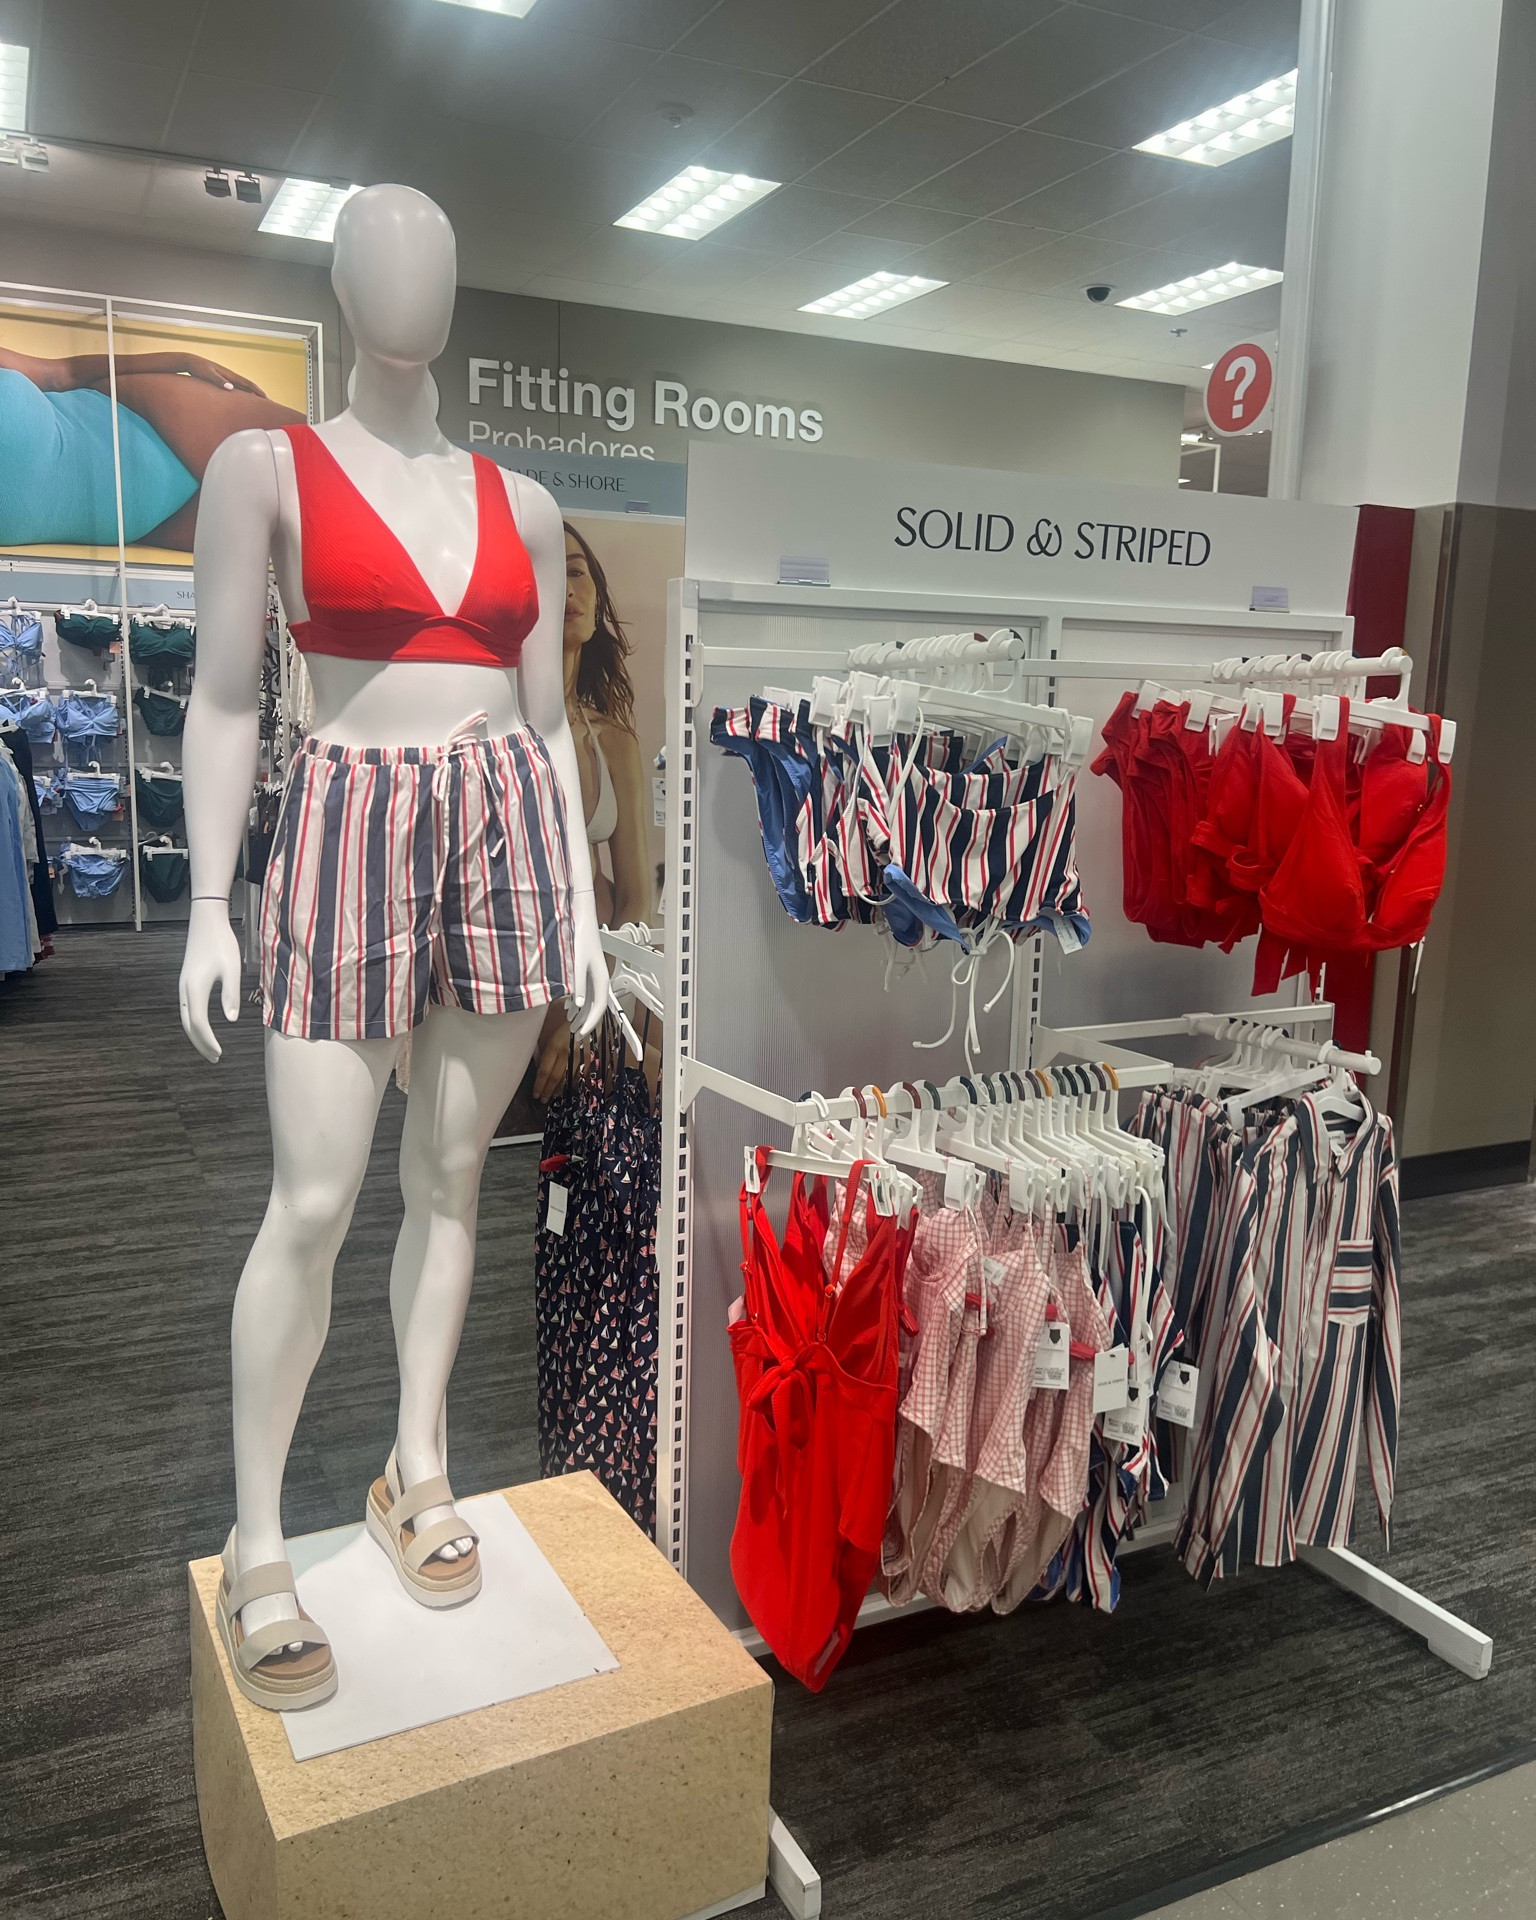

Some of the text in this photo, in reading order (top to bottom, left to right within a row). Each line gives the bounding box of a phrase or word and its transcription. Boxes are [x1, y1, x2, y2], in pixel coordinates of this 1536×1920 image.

[468, 357, 824, 442] Fitting Rooms
[469, 420, 655, 461] Probadores
[552, 471, 565, 487] &
[568, 473, 628, 492] SHORE
[894, 506, 1211, 567] SOLID & STRIPED
